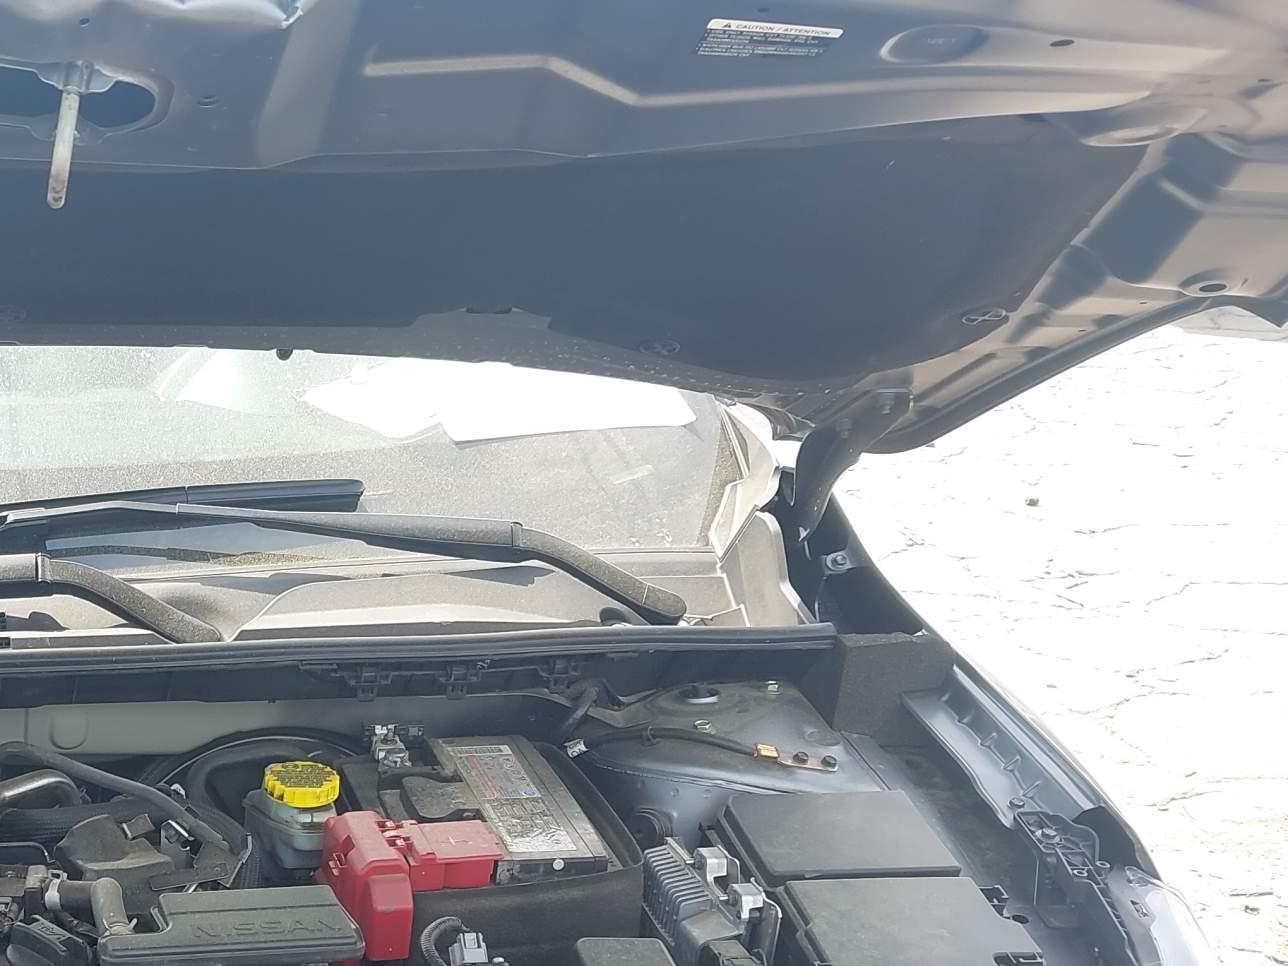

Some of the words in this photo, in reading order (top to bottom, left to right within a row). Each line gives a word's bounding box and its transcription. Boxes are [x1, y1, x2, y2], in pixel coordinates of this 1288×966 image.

[735, 23, 775, 31] CAUTION
[783, 26, 831, 36] ATTENTION
[193, 918, 342, 939] NISSAN
